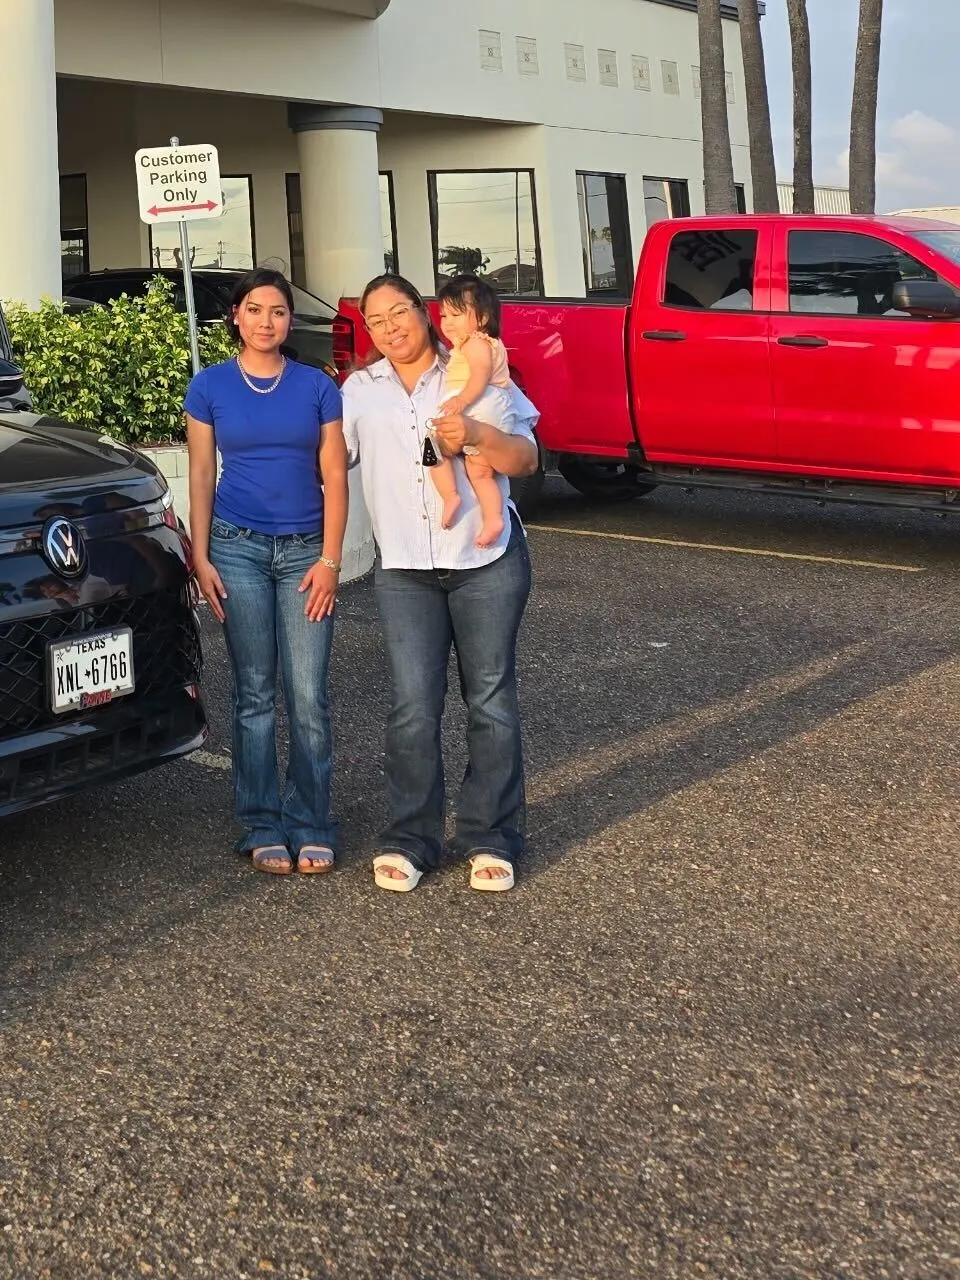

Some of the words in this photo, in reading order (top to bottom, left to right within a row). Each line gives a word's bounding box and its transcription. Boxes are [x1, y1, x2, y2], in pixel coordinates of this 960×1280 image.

[140, 151, 213, 168] Customer
[149, 169, 207, 185] Parking
[163, 187, 198, 203] Only
[77, 637, 106, 655] TEXAS
